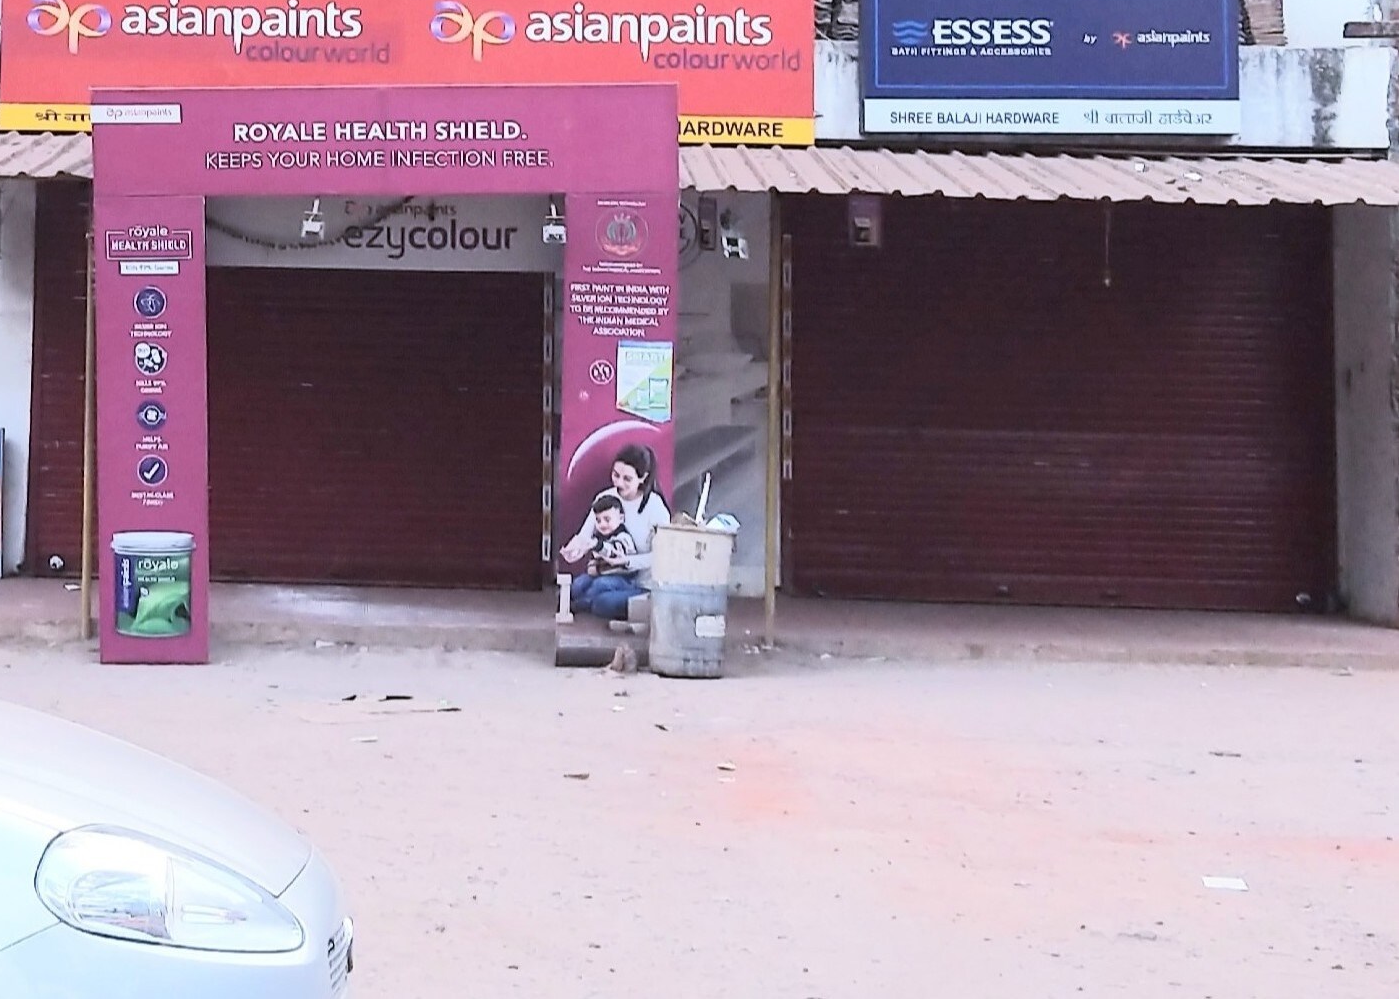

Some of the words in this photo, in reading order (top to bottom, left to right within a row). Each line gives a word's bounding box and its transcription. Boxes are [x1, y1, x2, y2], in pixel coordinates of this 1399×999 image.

[524, 2, 773, 63] asianpaints
[932, 18, 1052, 46] ESSESS
[1083, 32, 1097, 45] by
[1136, 30, 1211, 48] asianpaints
[890, 110, 933, 125] SHREE
[937, 110, 982, 125] BALAJI
[986, 110, 1060, 125] HARDWARE
[233, 123, 326, 143] ROYALE
[334, 121, 427, 141] HEALTH
[435, 121, 528, 141] SHIELD.
[206, 151, 262, 170] KEEPS
[267, 151, 320, 169] YOUR
[325, 150, 386, 168] HOME
[390, 150, 496, 168] INFECTION
[111, 239, 149, 251] HEALTH
[344, 217, 518, 260] ezycolour
[570, 283, 590, 292] FIRST
[592, 283, 614, 293] PAINT
[615, 284, 624, 293] IN
[625, 284, 648, 294] INDIA
[648, 285, 670, 295] WITH
[571, 293, 596, 302] SILVER
[597, 294, 613, 303] ION
[614, 295, 668, 306] TECHNOLOGY
[570, 304, 581, 313] TO
[595, 316, 622, 326] INDIAN
[624, 316, 659, 327] MEDICAL
[592, 326, 645, 337] ASSOCIATION
